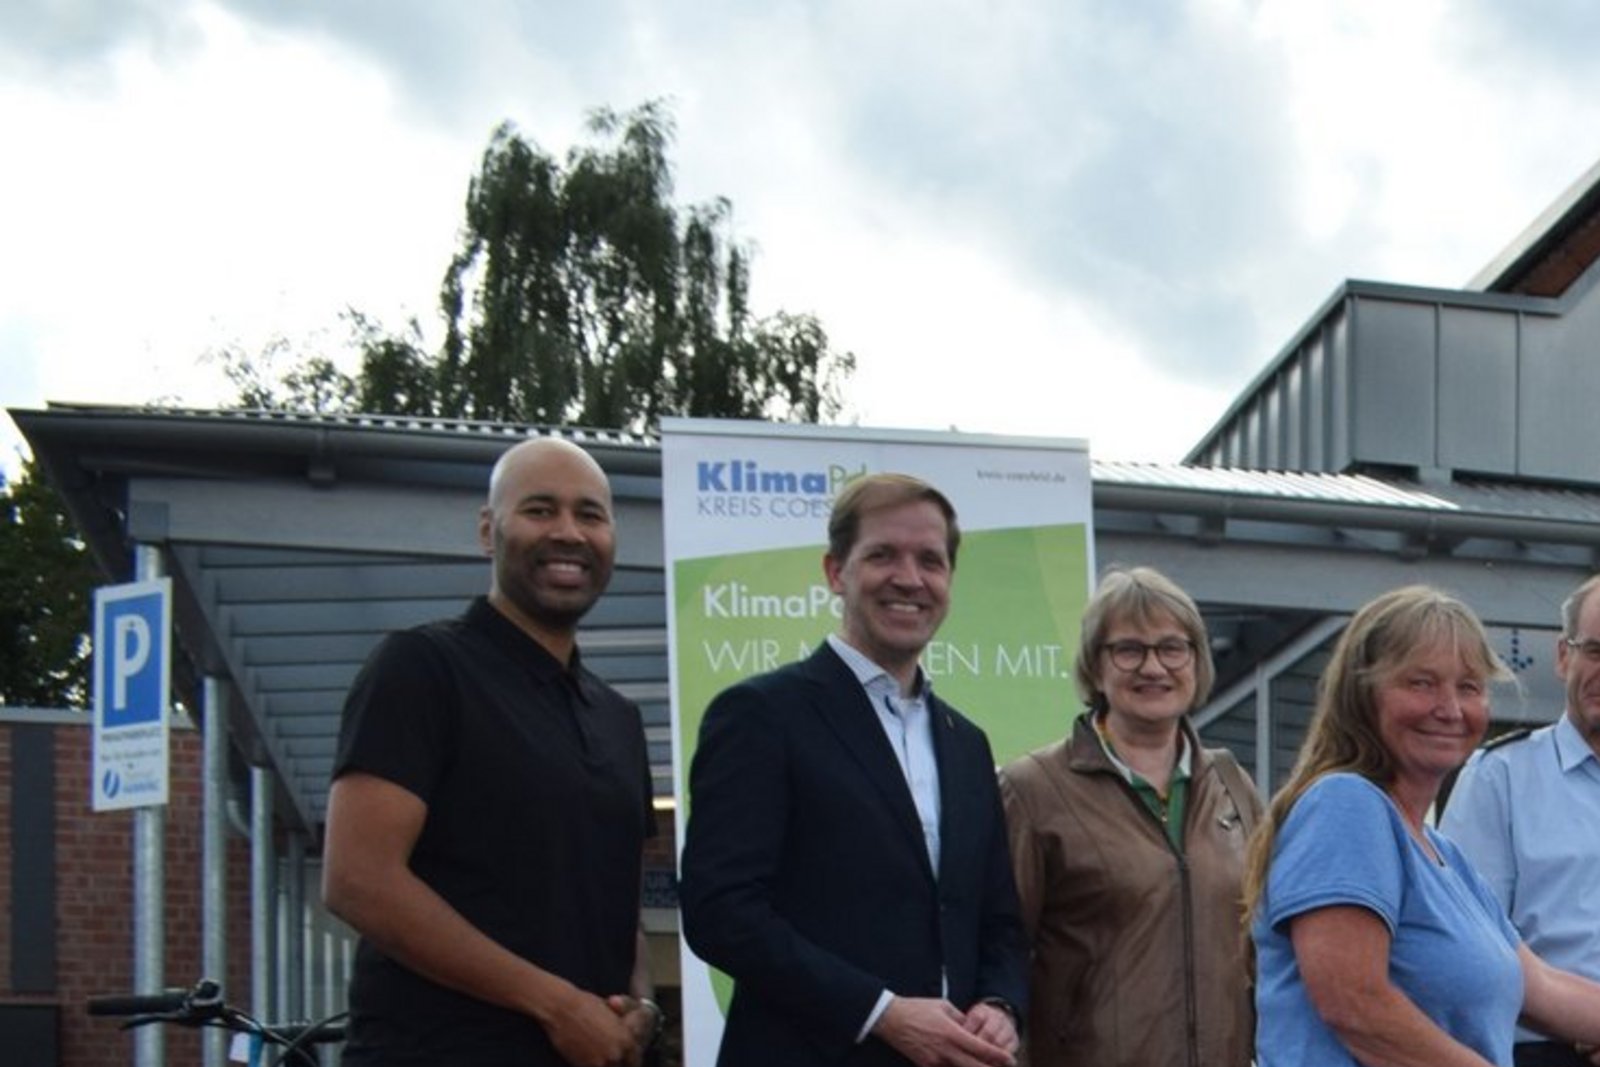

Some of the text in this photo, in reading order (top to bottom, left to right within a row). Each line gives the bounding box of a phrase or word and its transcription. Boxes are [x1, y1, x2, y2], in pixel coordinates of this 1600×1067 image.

[697, 497, 762, 518] KREIS
[113, 613, 152, 711] P
[703, 639, 778, 673] WIR
[995, 644, 1069, 679] MIT.
